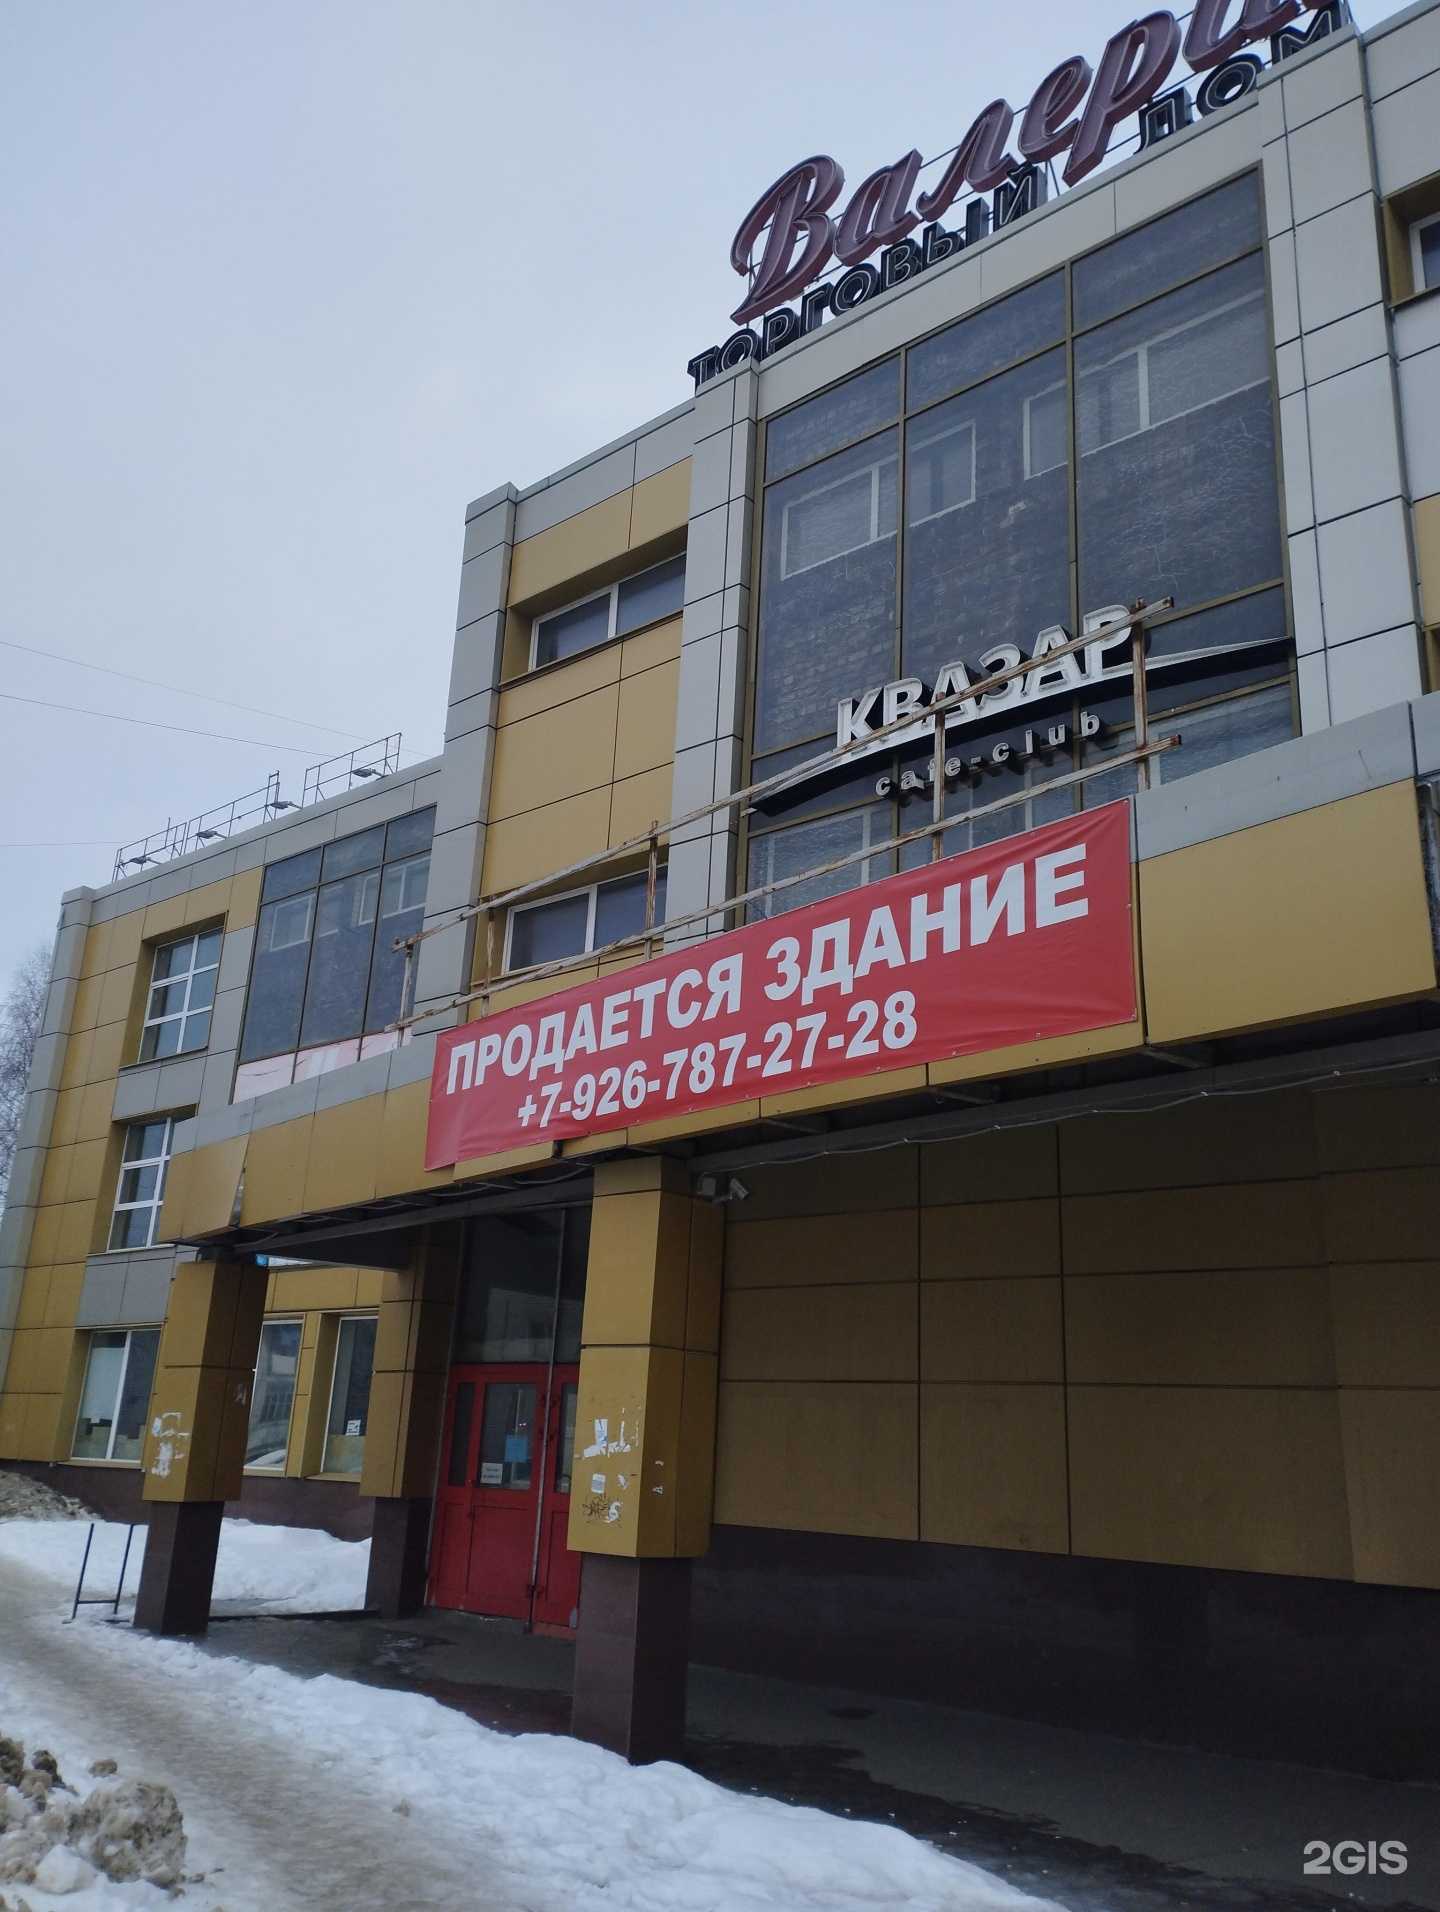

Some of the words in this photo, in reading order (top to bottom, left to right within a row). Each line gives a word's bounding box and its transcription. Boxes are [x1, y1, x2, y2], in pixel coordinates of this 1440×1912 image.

[687, 160, 1048, 397] ТОРГОВЫЙ
[730, 0, 1342, 326] Валери
[837, 604, 1133, 752] КВАЗАР
[446, 953, 744, 1095] ПРОДАЕТСЯ
[764, 843, 1090, 1006] ЗДАНИЕ
[517, 991, 919, 1129] +7-926-787-27-28
